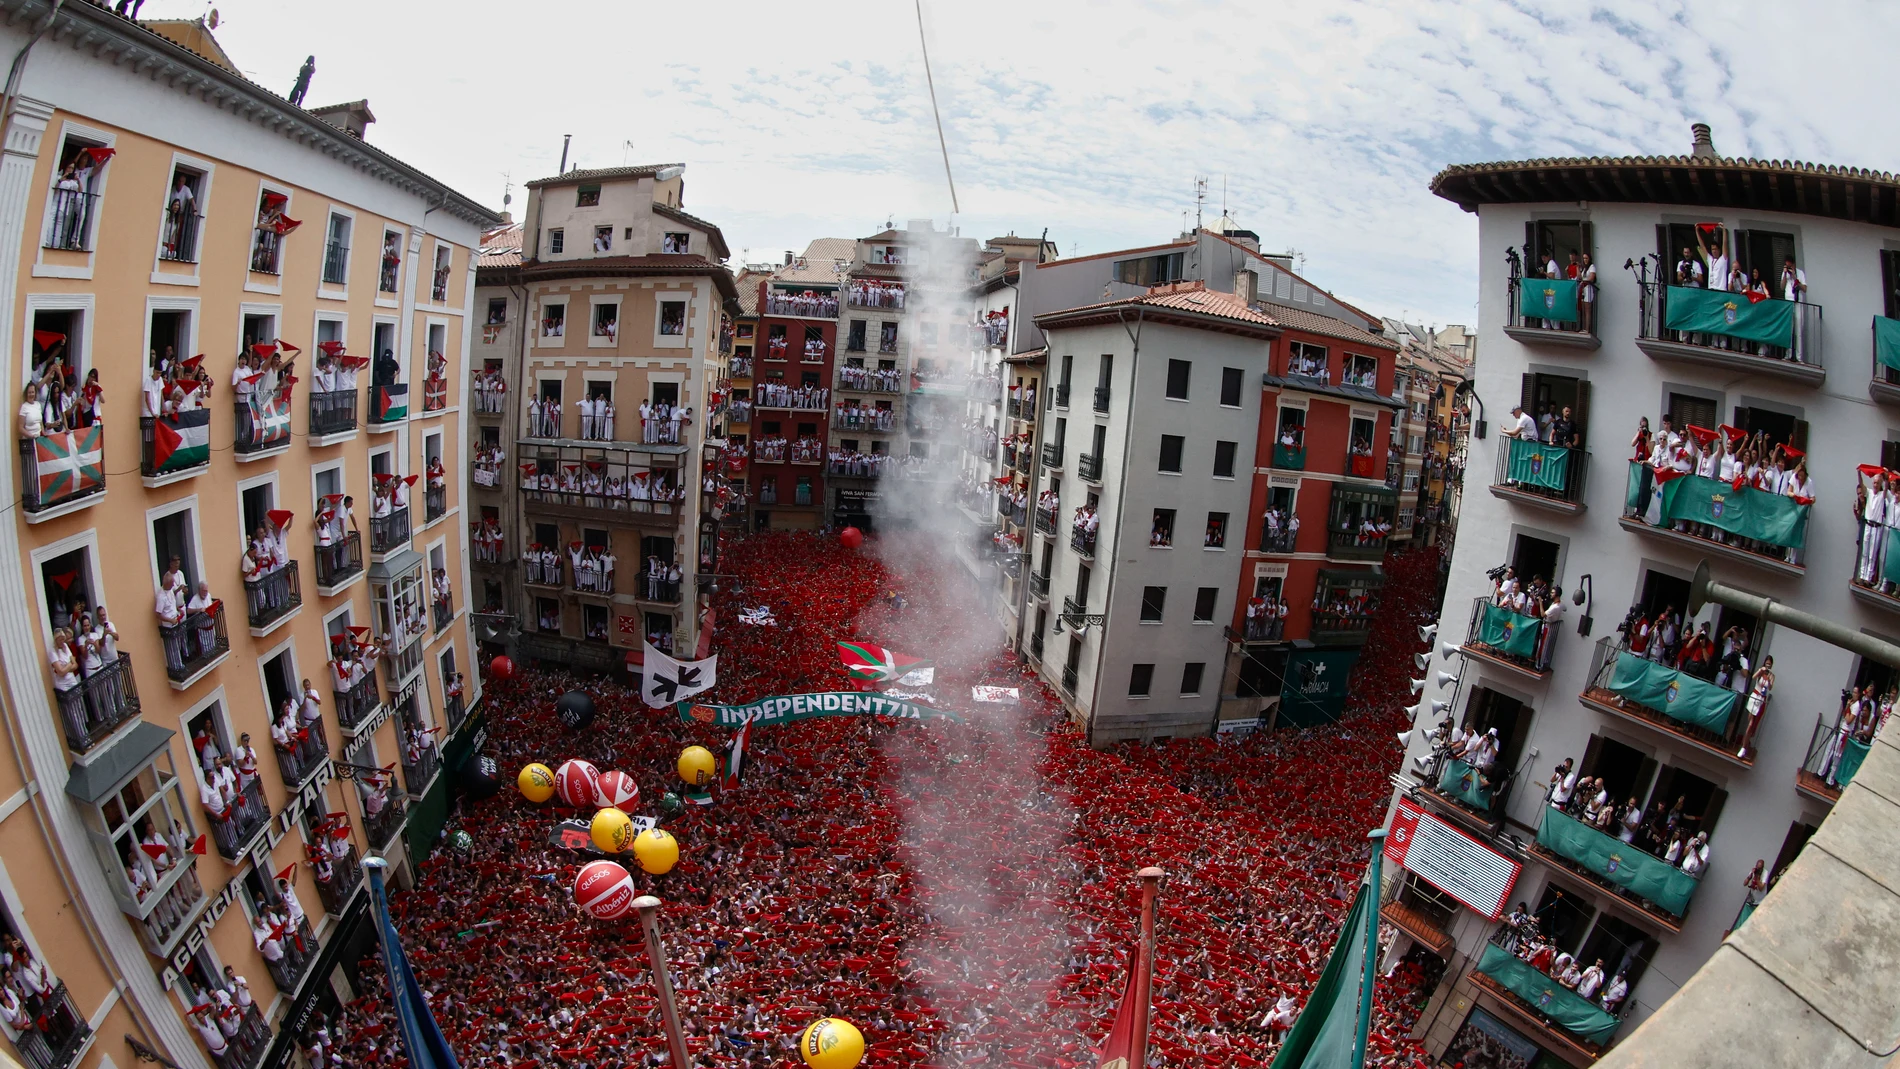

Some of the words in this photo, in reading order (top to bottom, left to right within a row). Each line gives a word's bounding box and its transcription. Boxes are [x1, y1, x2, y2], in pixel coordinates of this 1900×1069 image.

[160, 877, 243, 992] AGENCIA
[251, 761, 335, 868] ELIZARI
[344, 674, 424, 760] INMOBILIARIA
[1395, 827, 1406, 842] 6
[581, 869, 611, 891] QUESOS
[594, 888, 631, 915] Albéniz
[295, 1012, 309, 1033] BAR
[809, 1020, 829, 1053] URZANTE
